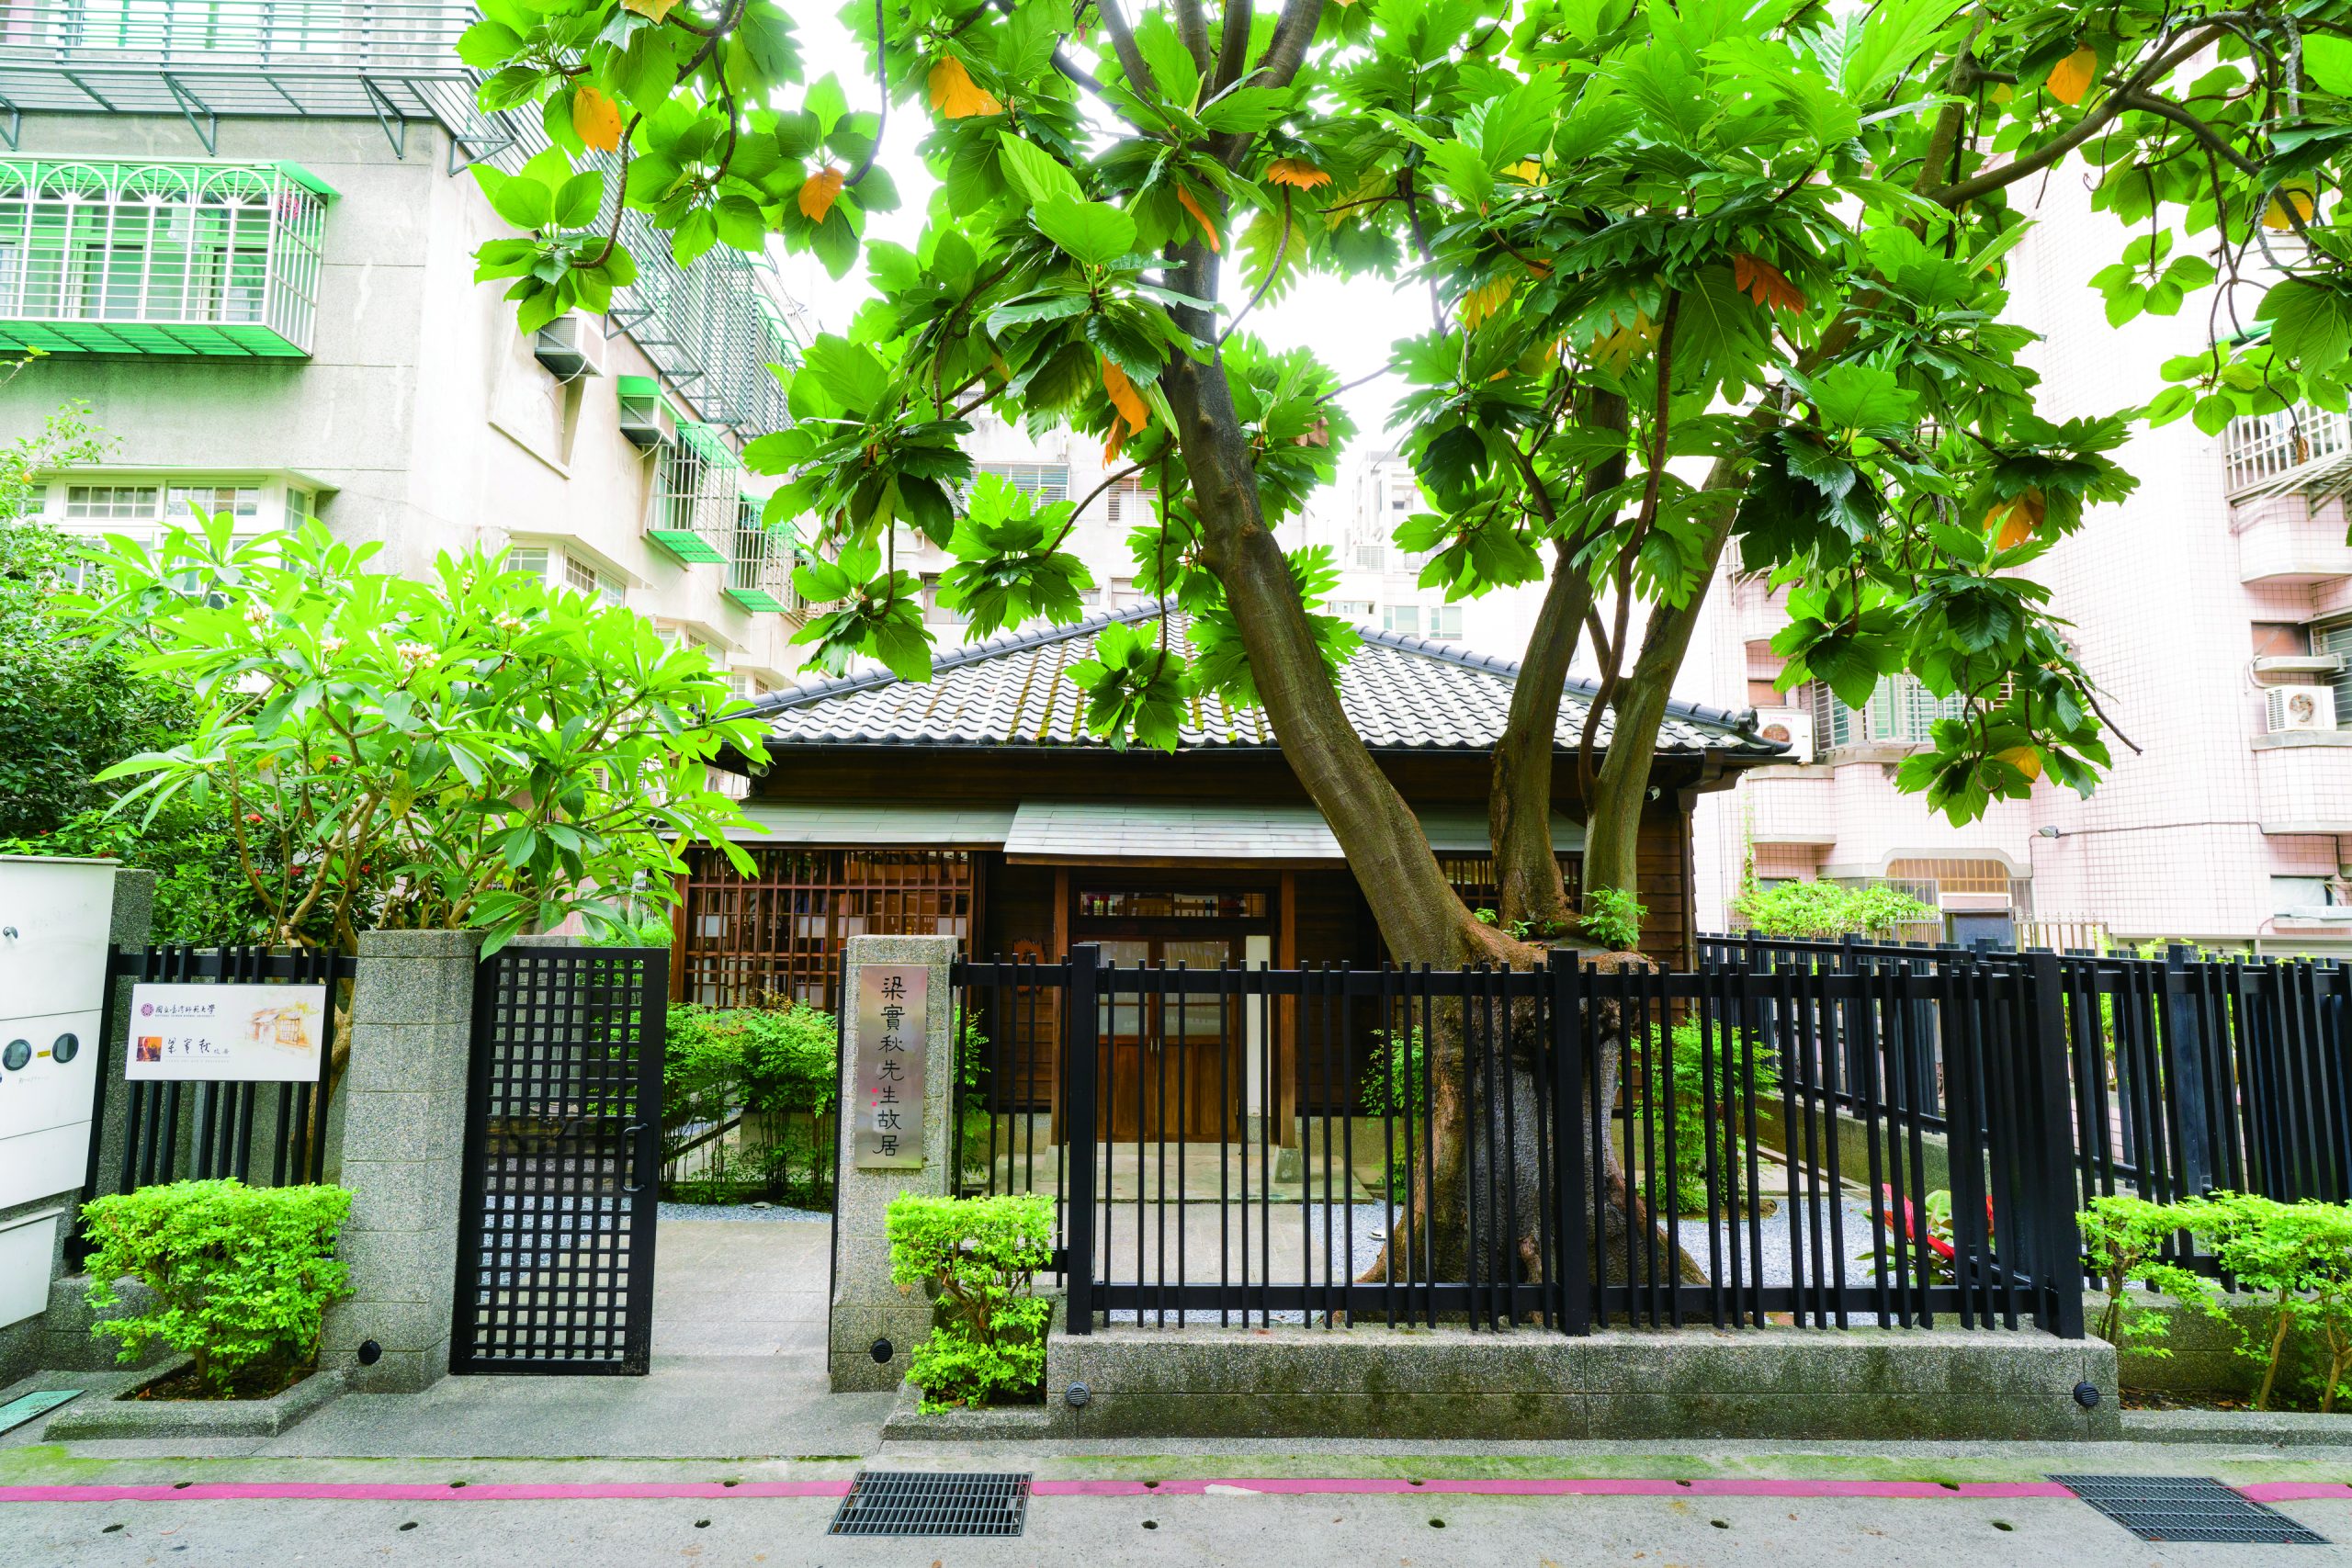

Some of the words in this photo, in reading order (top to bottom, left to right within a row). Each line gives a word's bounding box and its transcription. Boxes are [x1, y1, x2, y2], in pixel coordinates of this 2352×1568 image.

[872, 976, 907, 1156] 梁實秋先生故居
